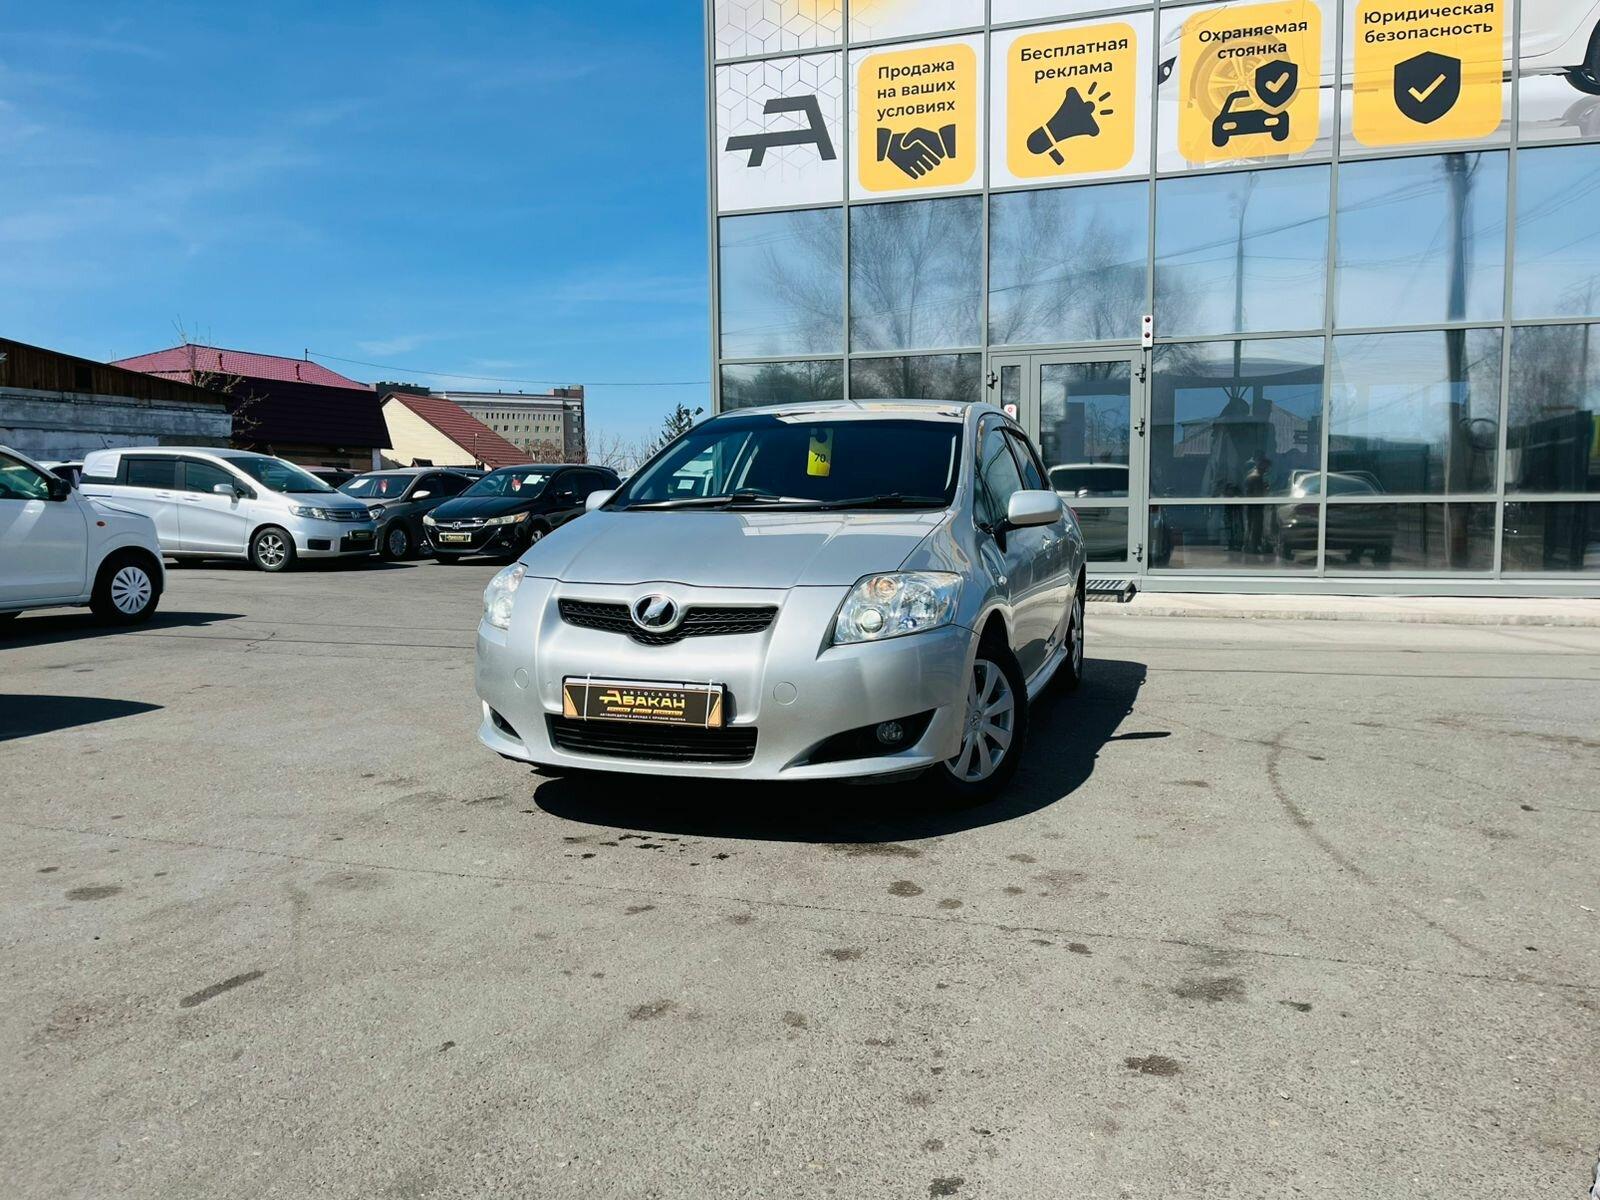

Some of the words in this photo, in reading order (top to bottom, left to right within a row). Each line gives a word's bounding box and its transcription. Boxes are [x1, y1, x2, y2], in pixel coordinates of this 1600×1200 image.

[1363, 2, 1495, 25] Юридическая
[1198, 19, 1308, 43] Охраняемая
[1364, 21, 1494, 44] безопасность
[1020, 38, 1128, 61] Бесплатная
[1217, 42, 1288, 60] стоянка
[878, 60, 955, 81] Продажа
[1034, 61, 1113, 83] реклама
[877, 87, 896, 99] на
[901, 80, 956, 96] ваших
[876, 100, 956, 122] условиях
